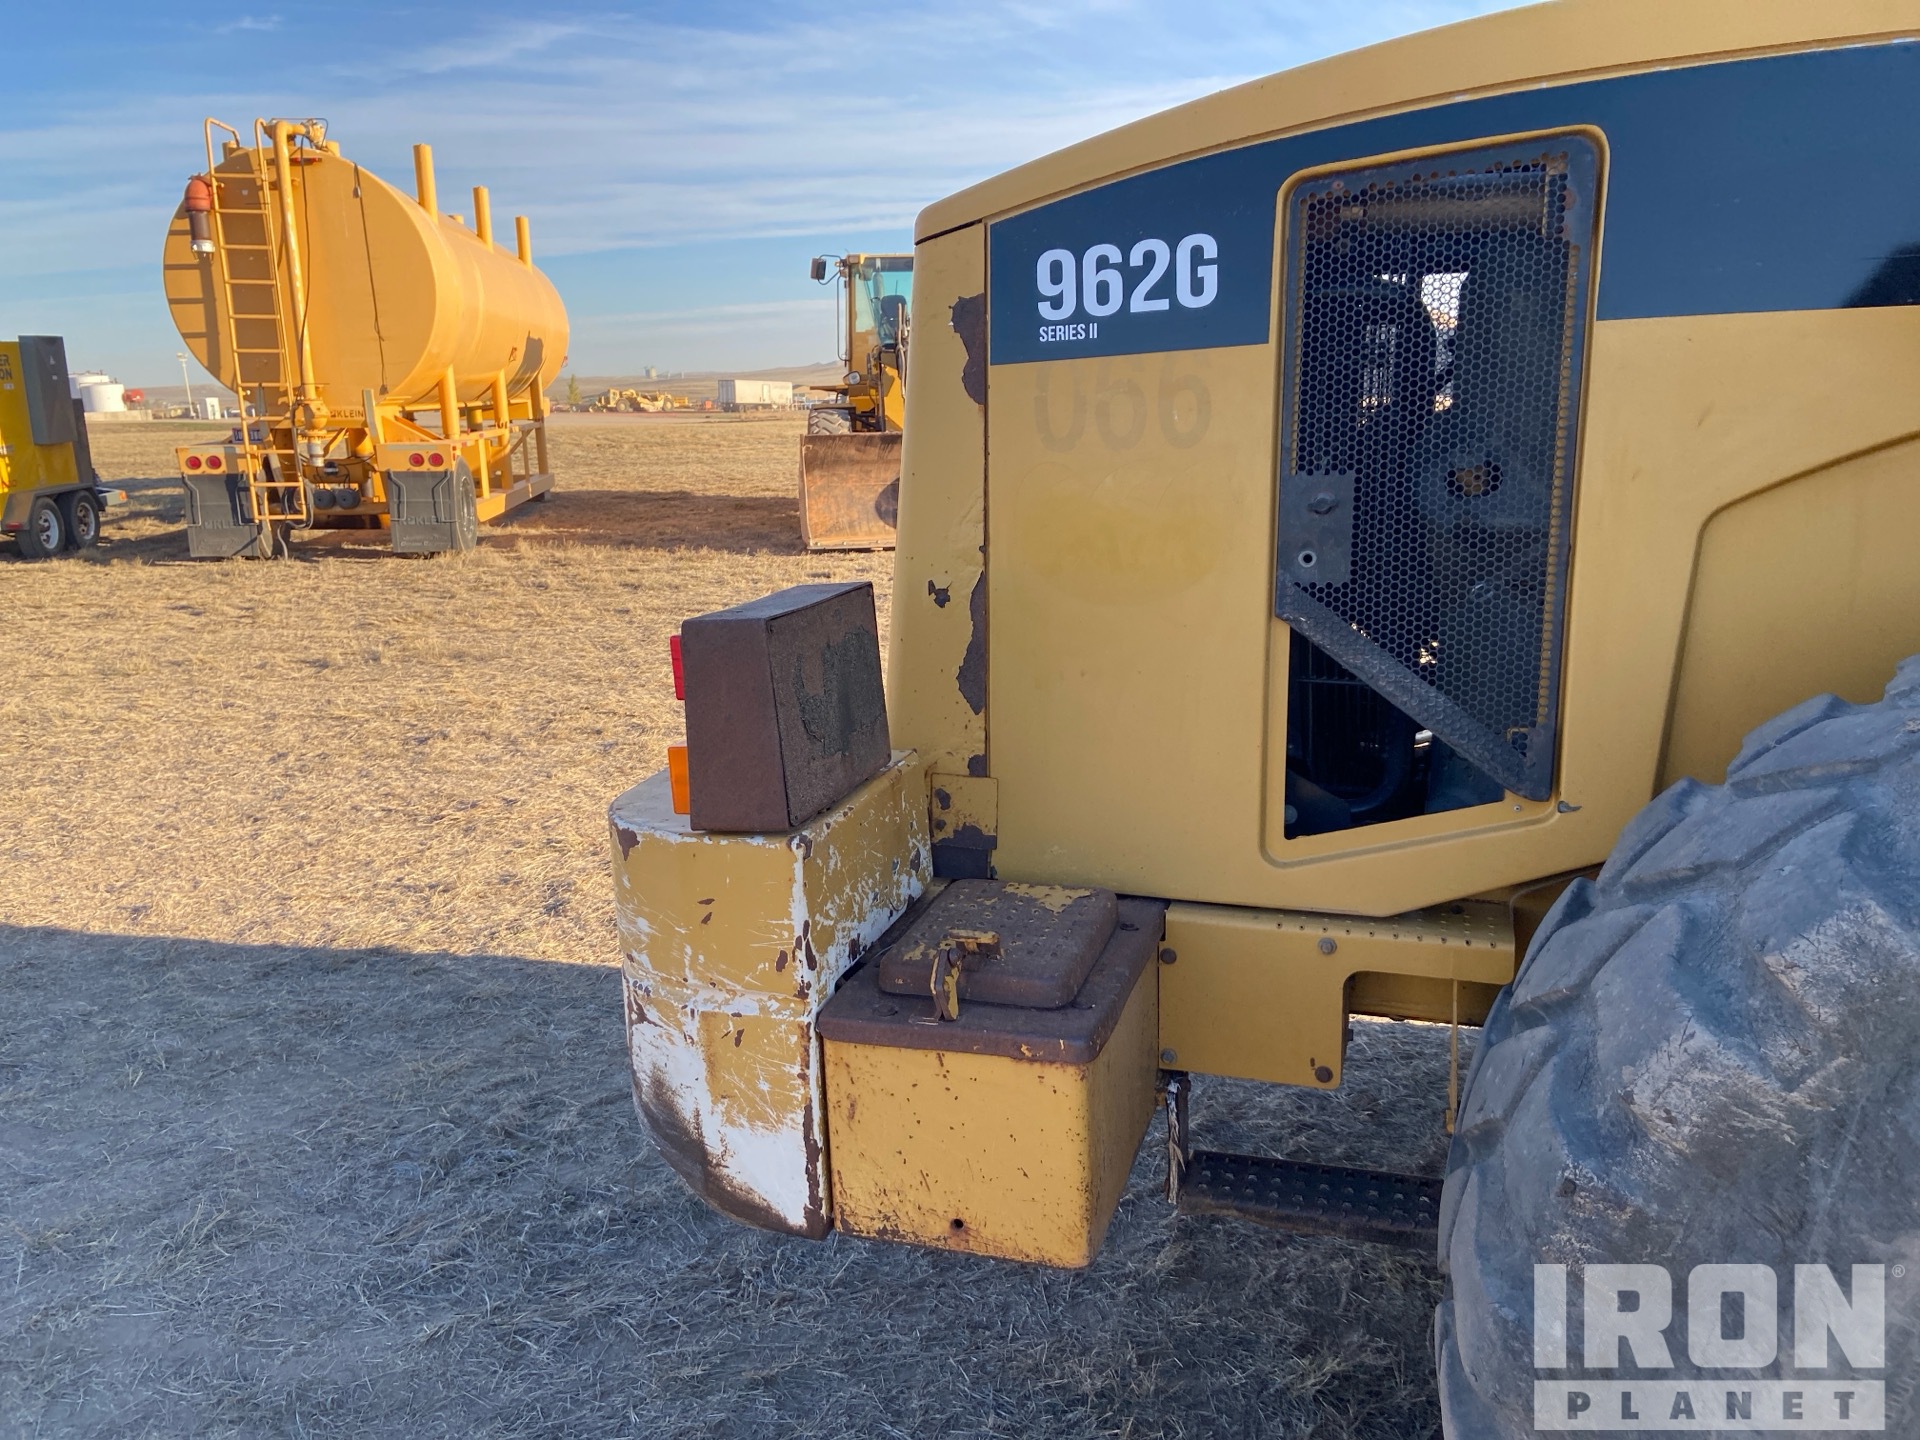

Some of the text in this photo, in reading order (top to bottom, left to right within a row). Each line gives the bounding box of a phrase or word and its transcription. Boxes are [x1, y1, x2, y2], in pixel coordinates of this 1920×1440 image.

[1036, 233, 1218, 320] 962G
[1039, 323, 1098, 342] SERIES II
[336, 409, 364, 418] KLEIN
